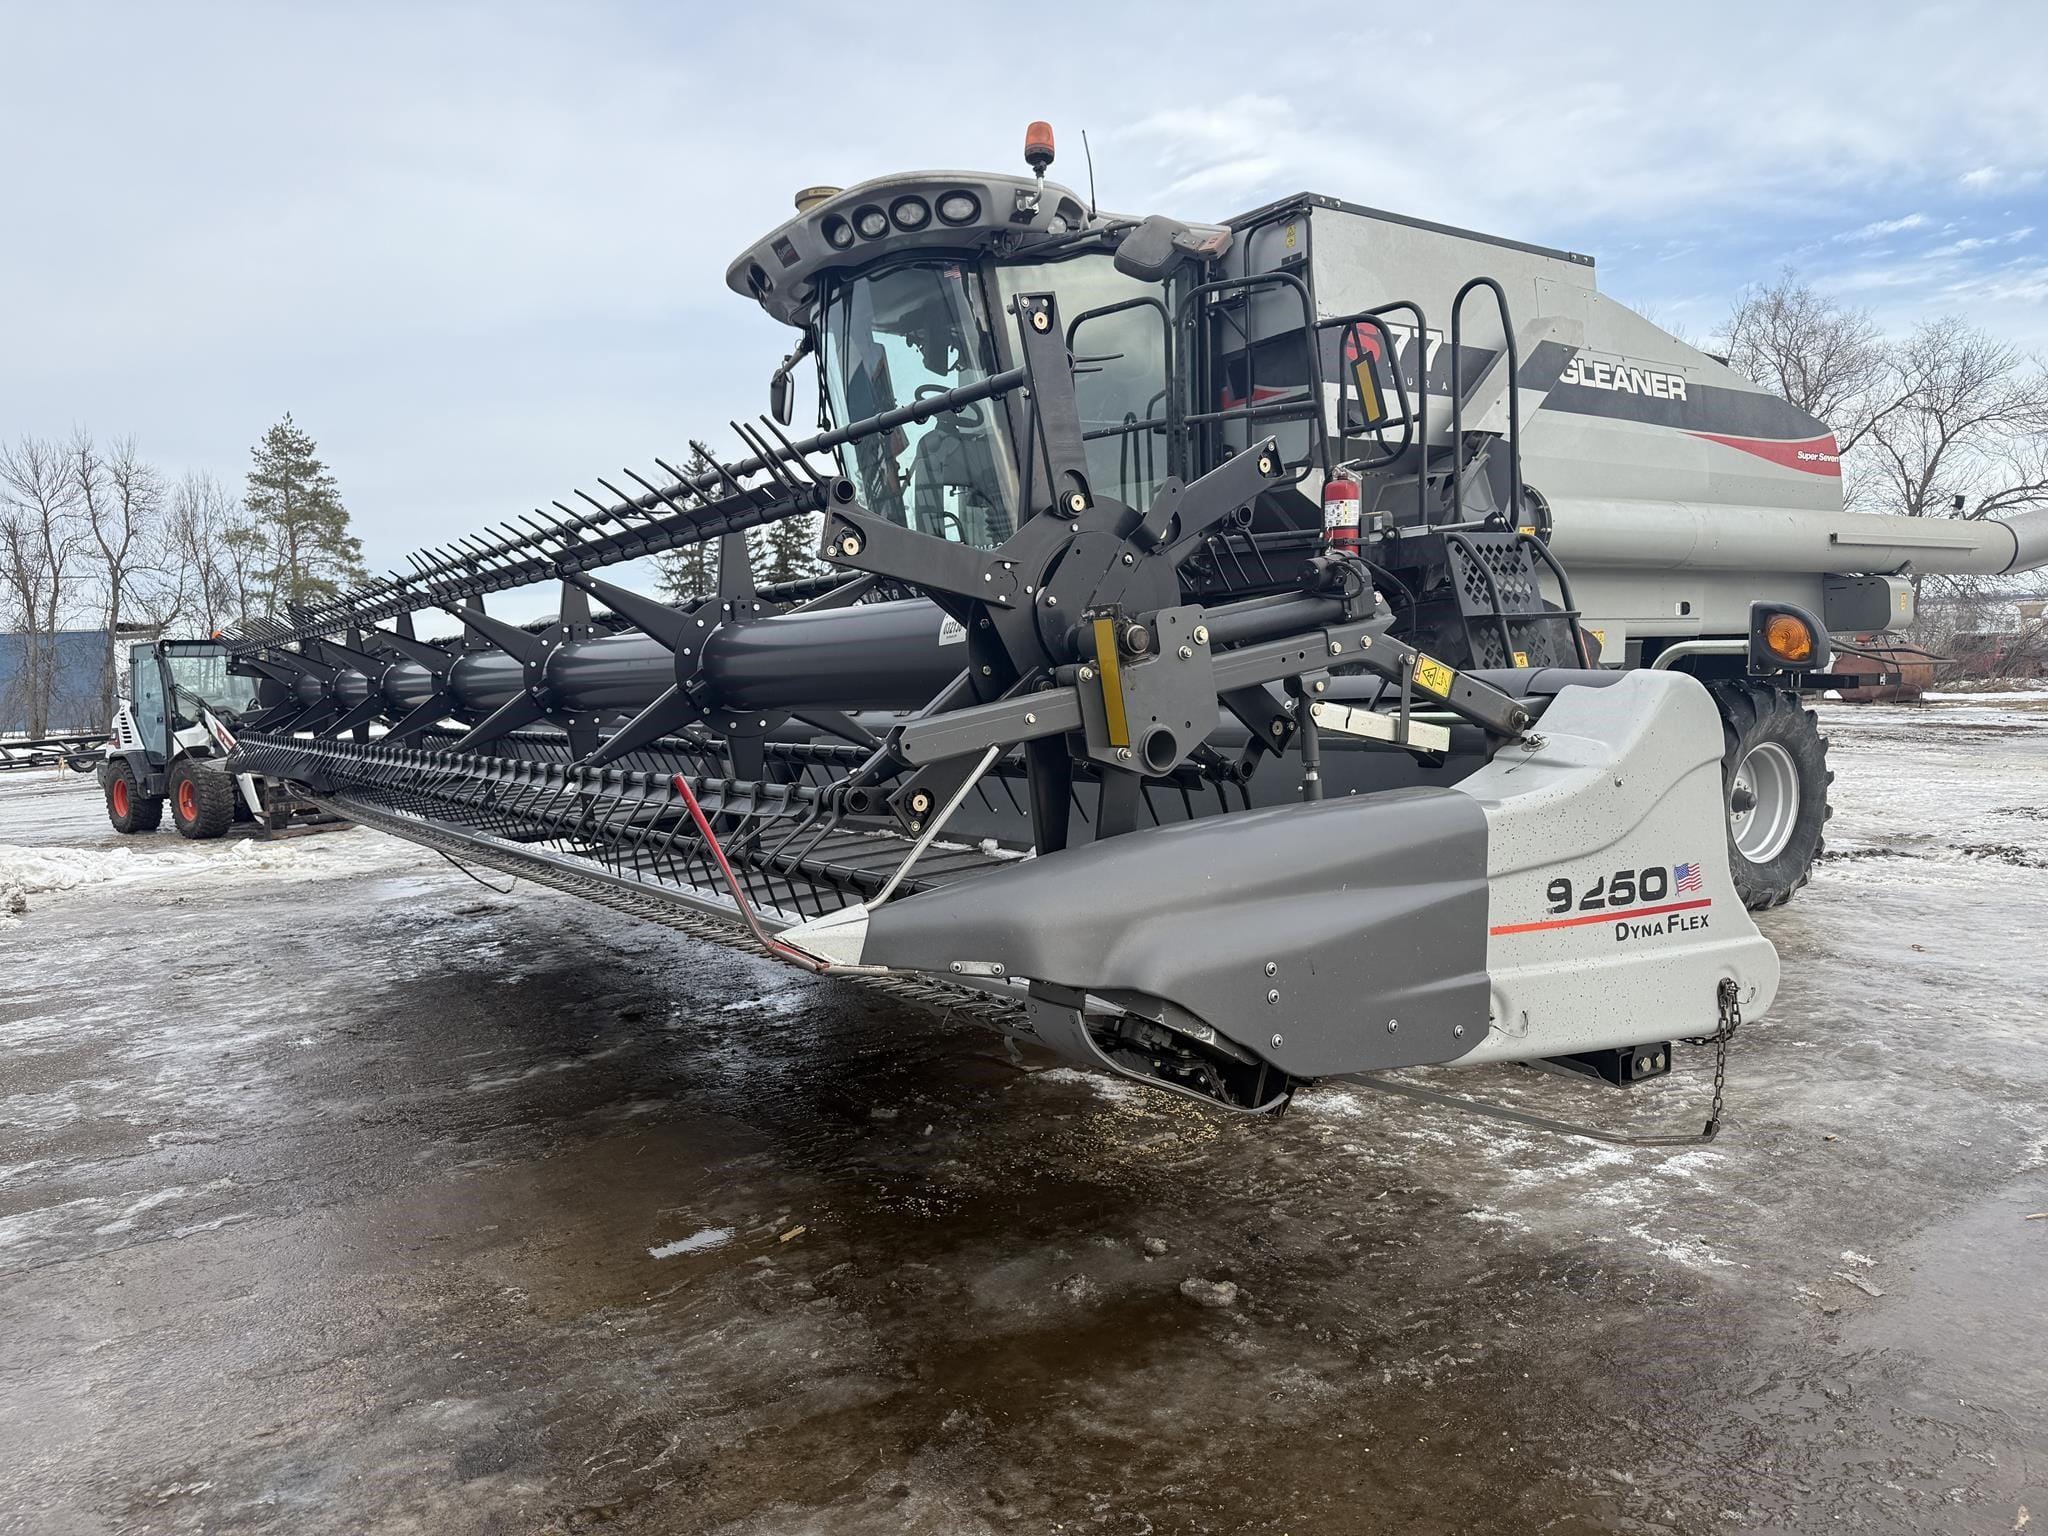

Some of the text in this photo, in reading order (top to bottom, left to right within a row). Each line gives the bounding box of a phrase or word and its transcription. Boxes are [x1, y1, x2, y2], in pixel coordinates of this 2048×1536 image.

[1560, 358, 1687, 401] GLEANER
[1797, 450, 1839, 463] Super Seven
[1547, 866, 1668, 915] 9250
